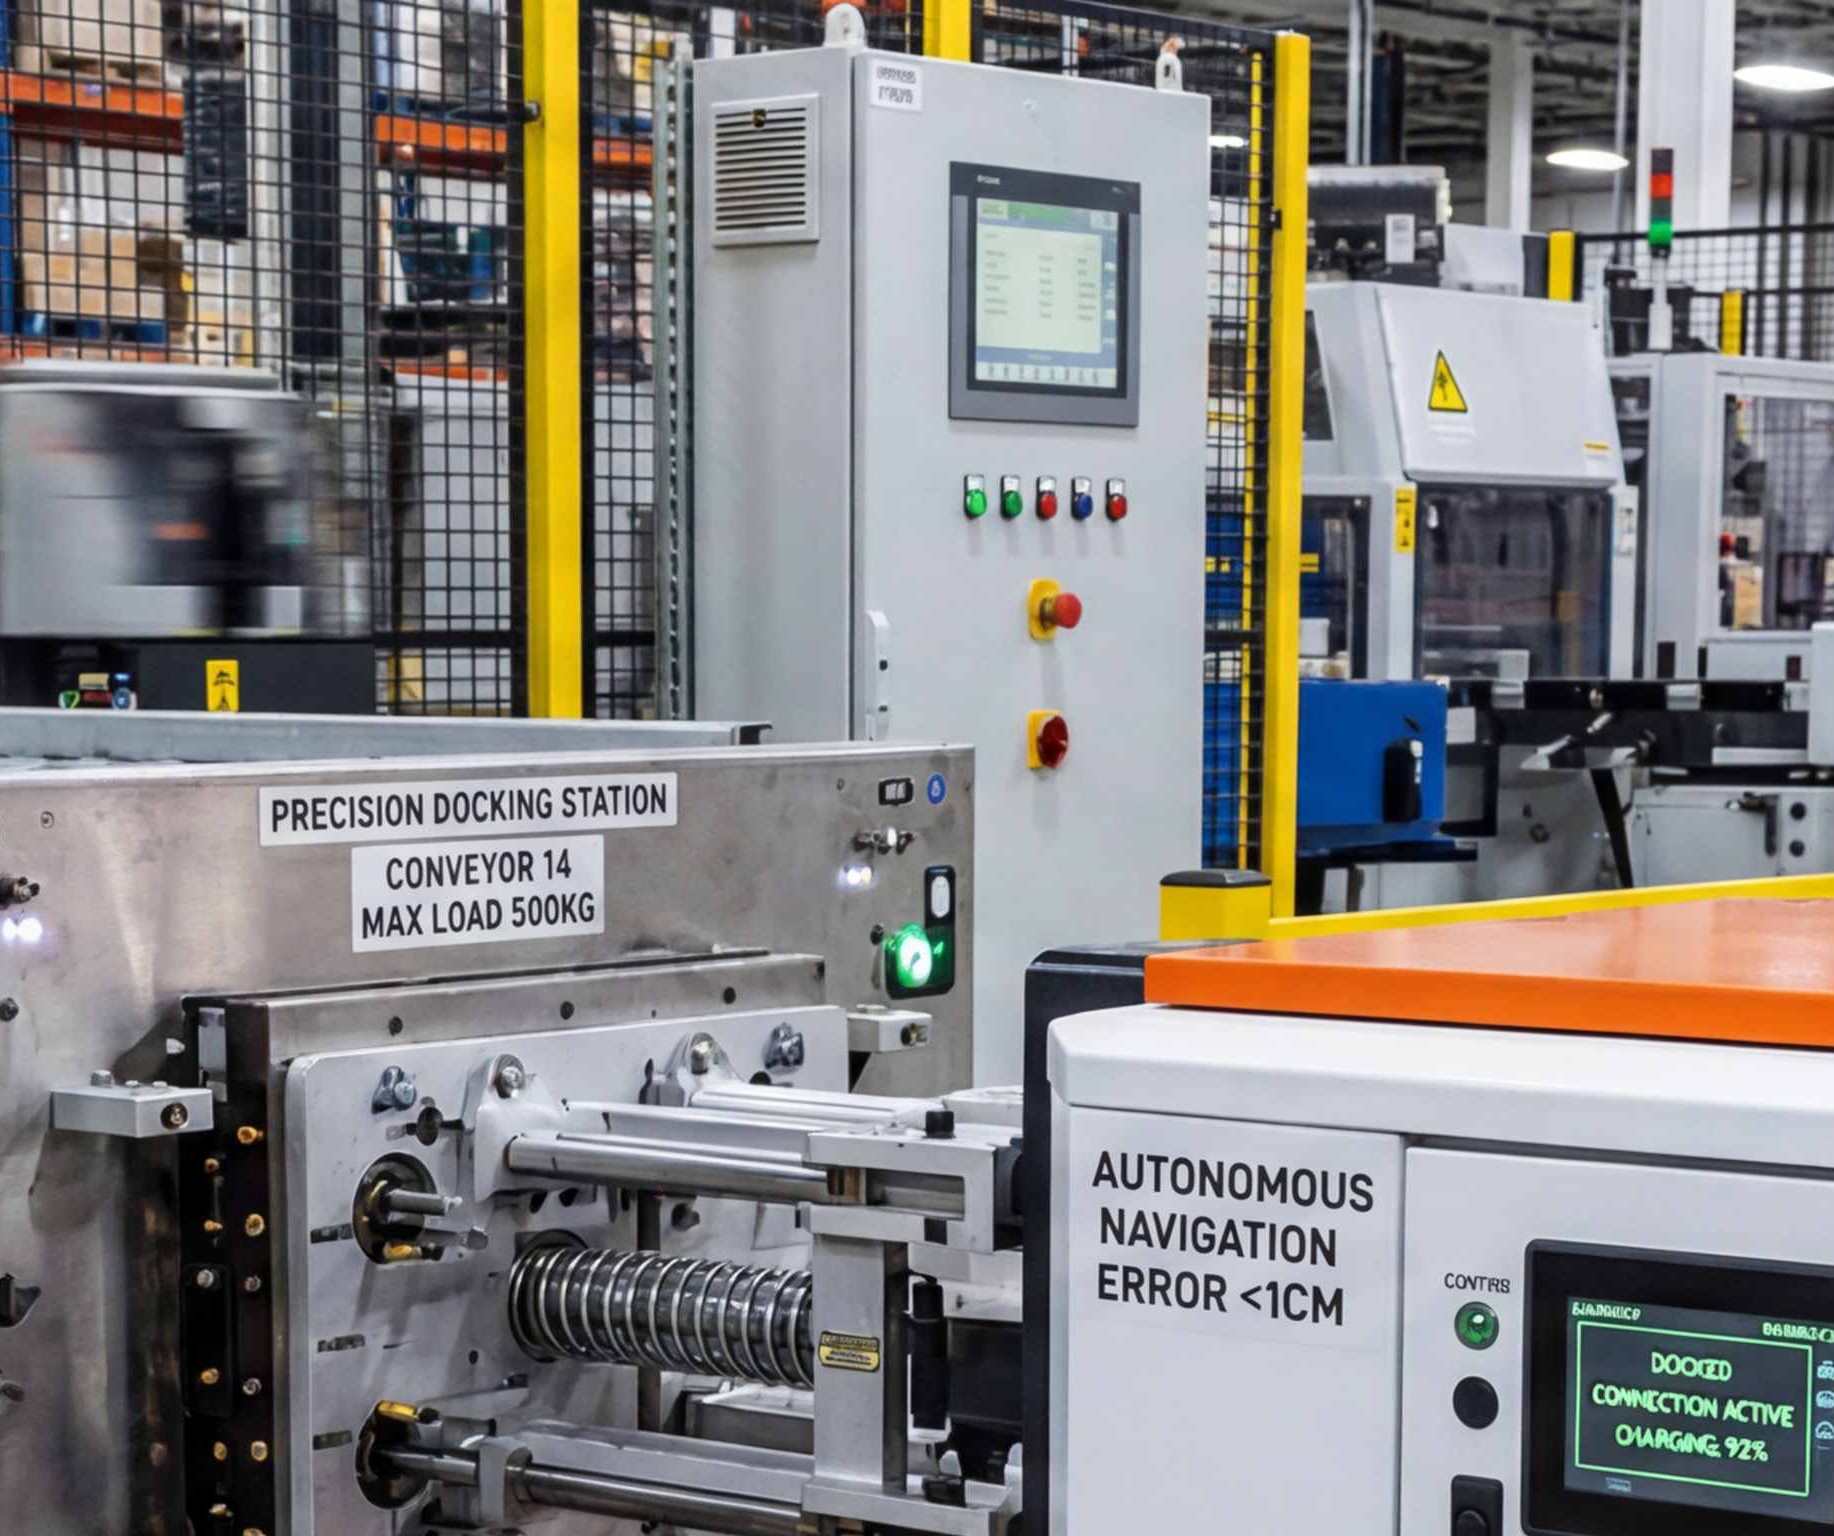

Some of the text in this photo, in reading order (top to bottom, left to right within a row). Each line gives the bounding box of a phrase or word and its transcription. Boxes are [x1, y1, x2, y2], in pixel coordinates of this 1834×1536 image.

[272, 783, 666, 832] PRECISION DOCKING STATION
[386, 848, 572, 890] CONVEYOR 14
[362, 891, 595, 939] MAX LOAD 500KG
[1092, 1150, 1374, 1213] AUTONOMOUS
[1100, 1206, 1336, 1267] NAVIGATION
[1098, 1262, 1344, 1326] ERROR <1CM
[1722, 1397, 1795, 1428] ACTIVE
